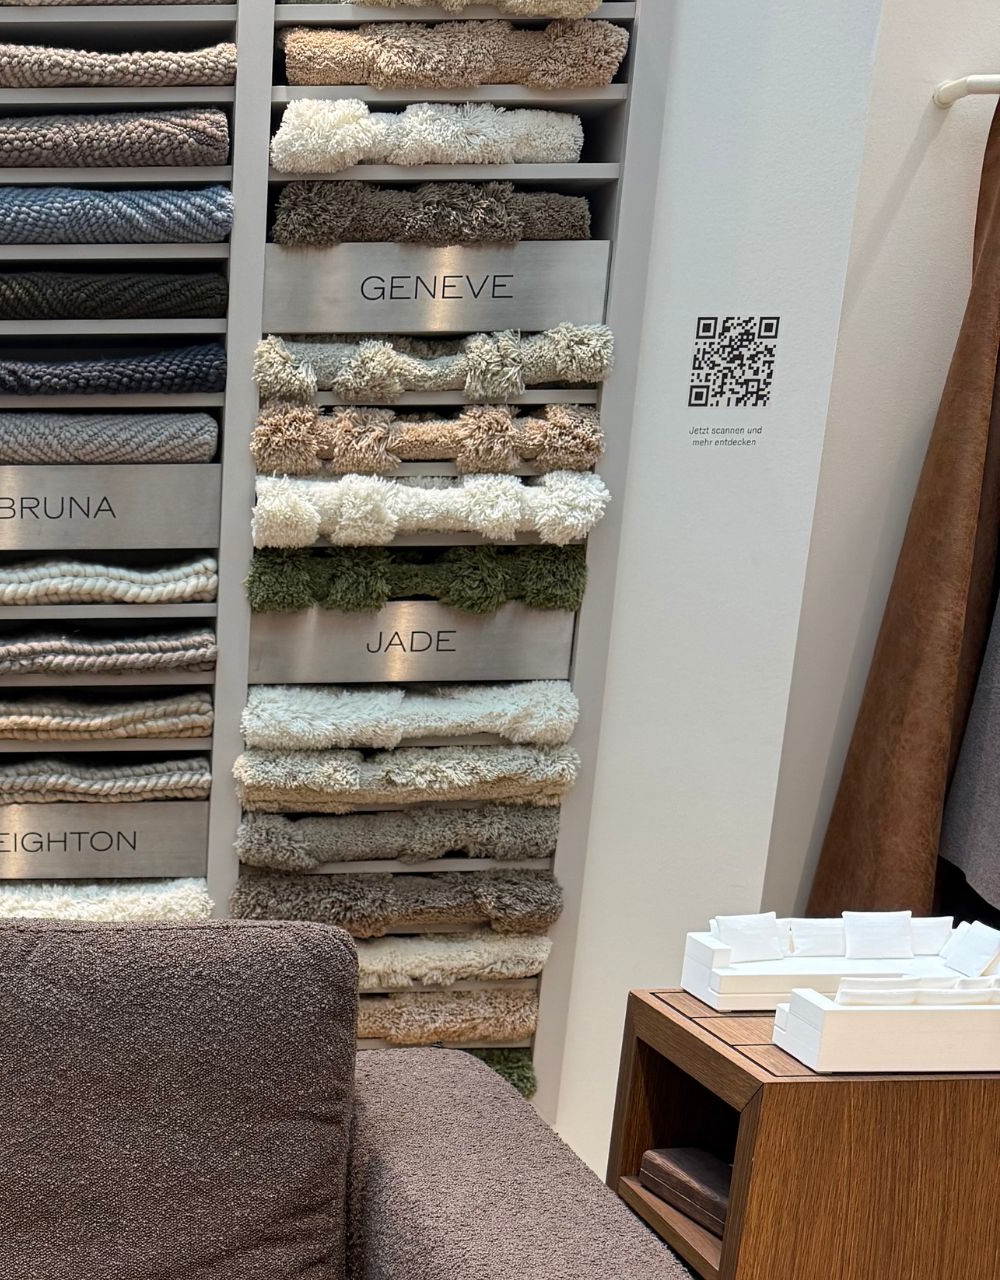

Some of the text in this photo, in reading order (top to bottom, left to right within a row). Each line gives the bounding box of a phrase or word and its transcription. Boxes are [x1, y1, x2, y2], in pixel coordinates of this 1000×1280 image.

[360, 274, 514, 301] GENEVE
[688, 425, 763, 436] Jetzt scannen und
[692, 437, 757, 447] mehr entdecken
[366, 630, 457, 654] JADE
